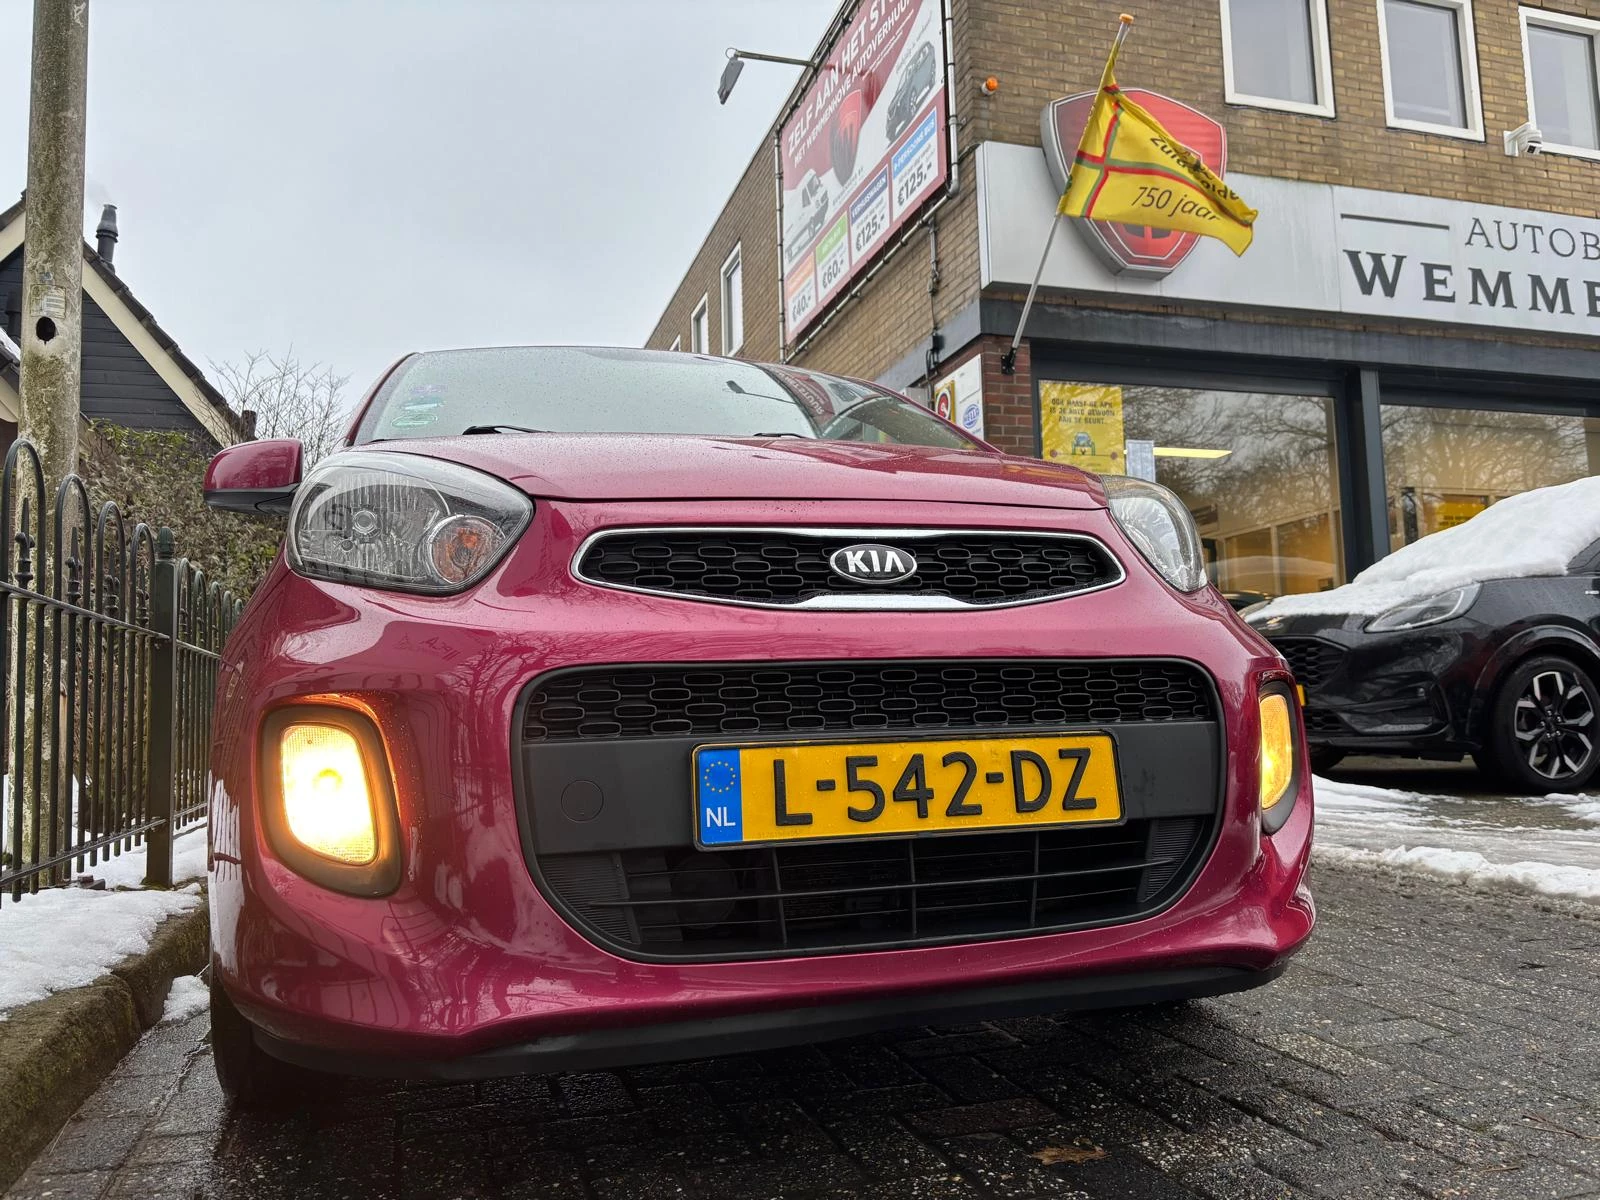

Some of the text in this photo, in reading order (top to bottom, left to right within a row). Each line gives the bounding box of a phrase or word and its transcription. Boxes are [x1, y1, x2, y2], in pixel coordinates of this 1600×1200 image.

[788, 103, 813, 158] ZELF
[814, 61, 839, 118] AAN
[841, 16, 867, 75] HET
[1131, 186, 1221, 221] 750 jaar
[844, 550, 905, 573] KIA
[773, 748, 1098, 827] L-542-DZ
[706, 807, 736, 828] NL
